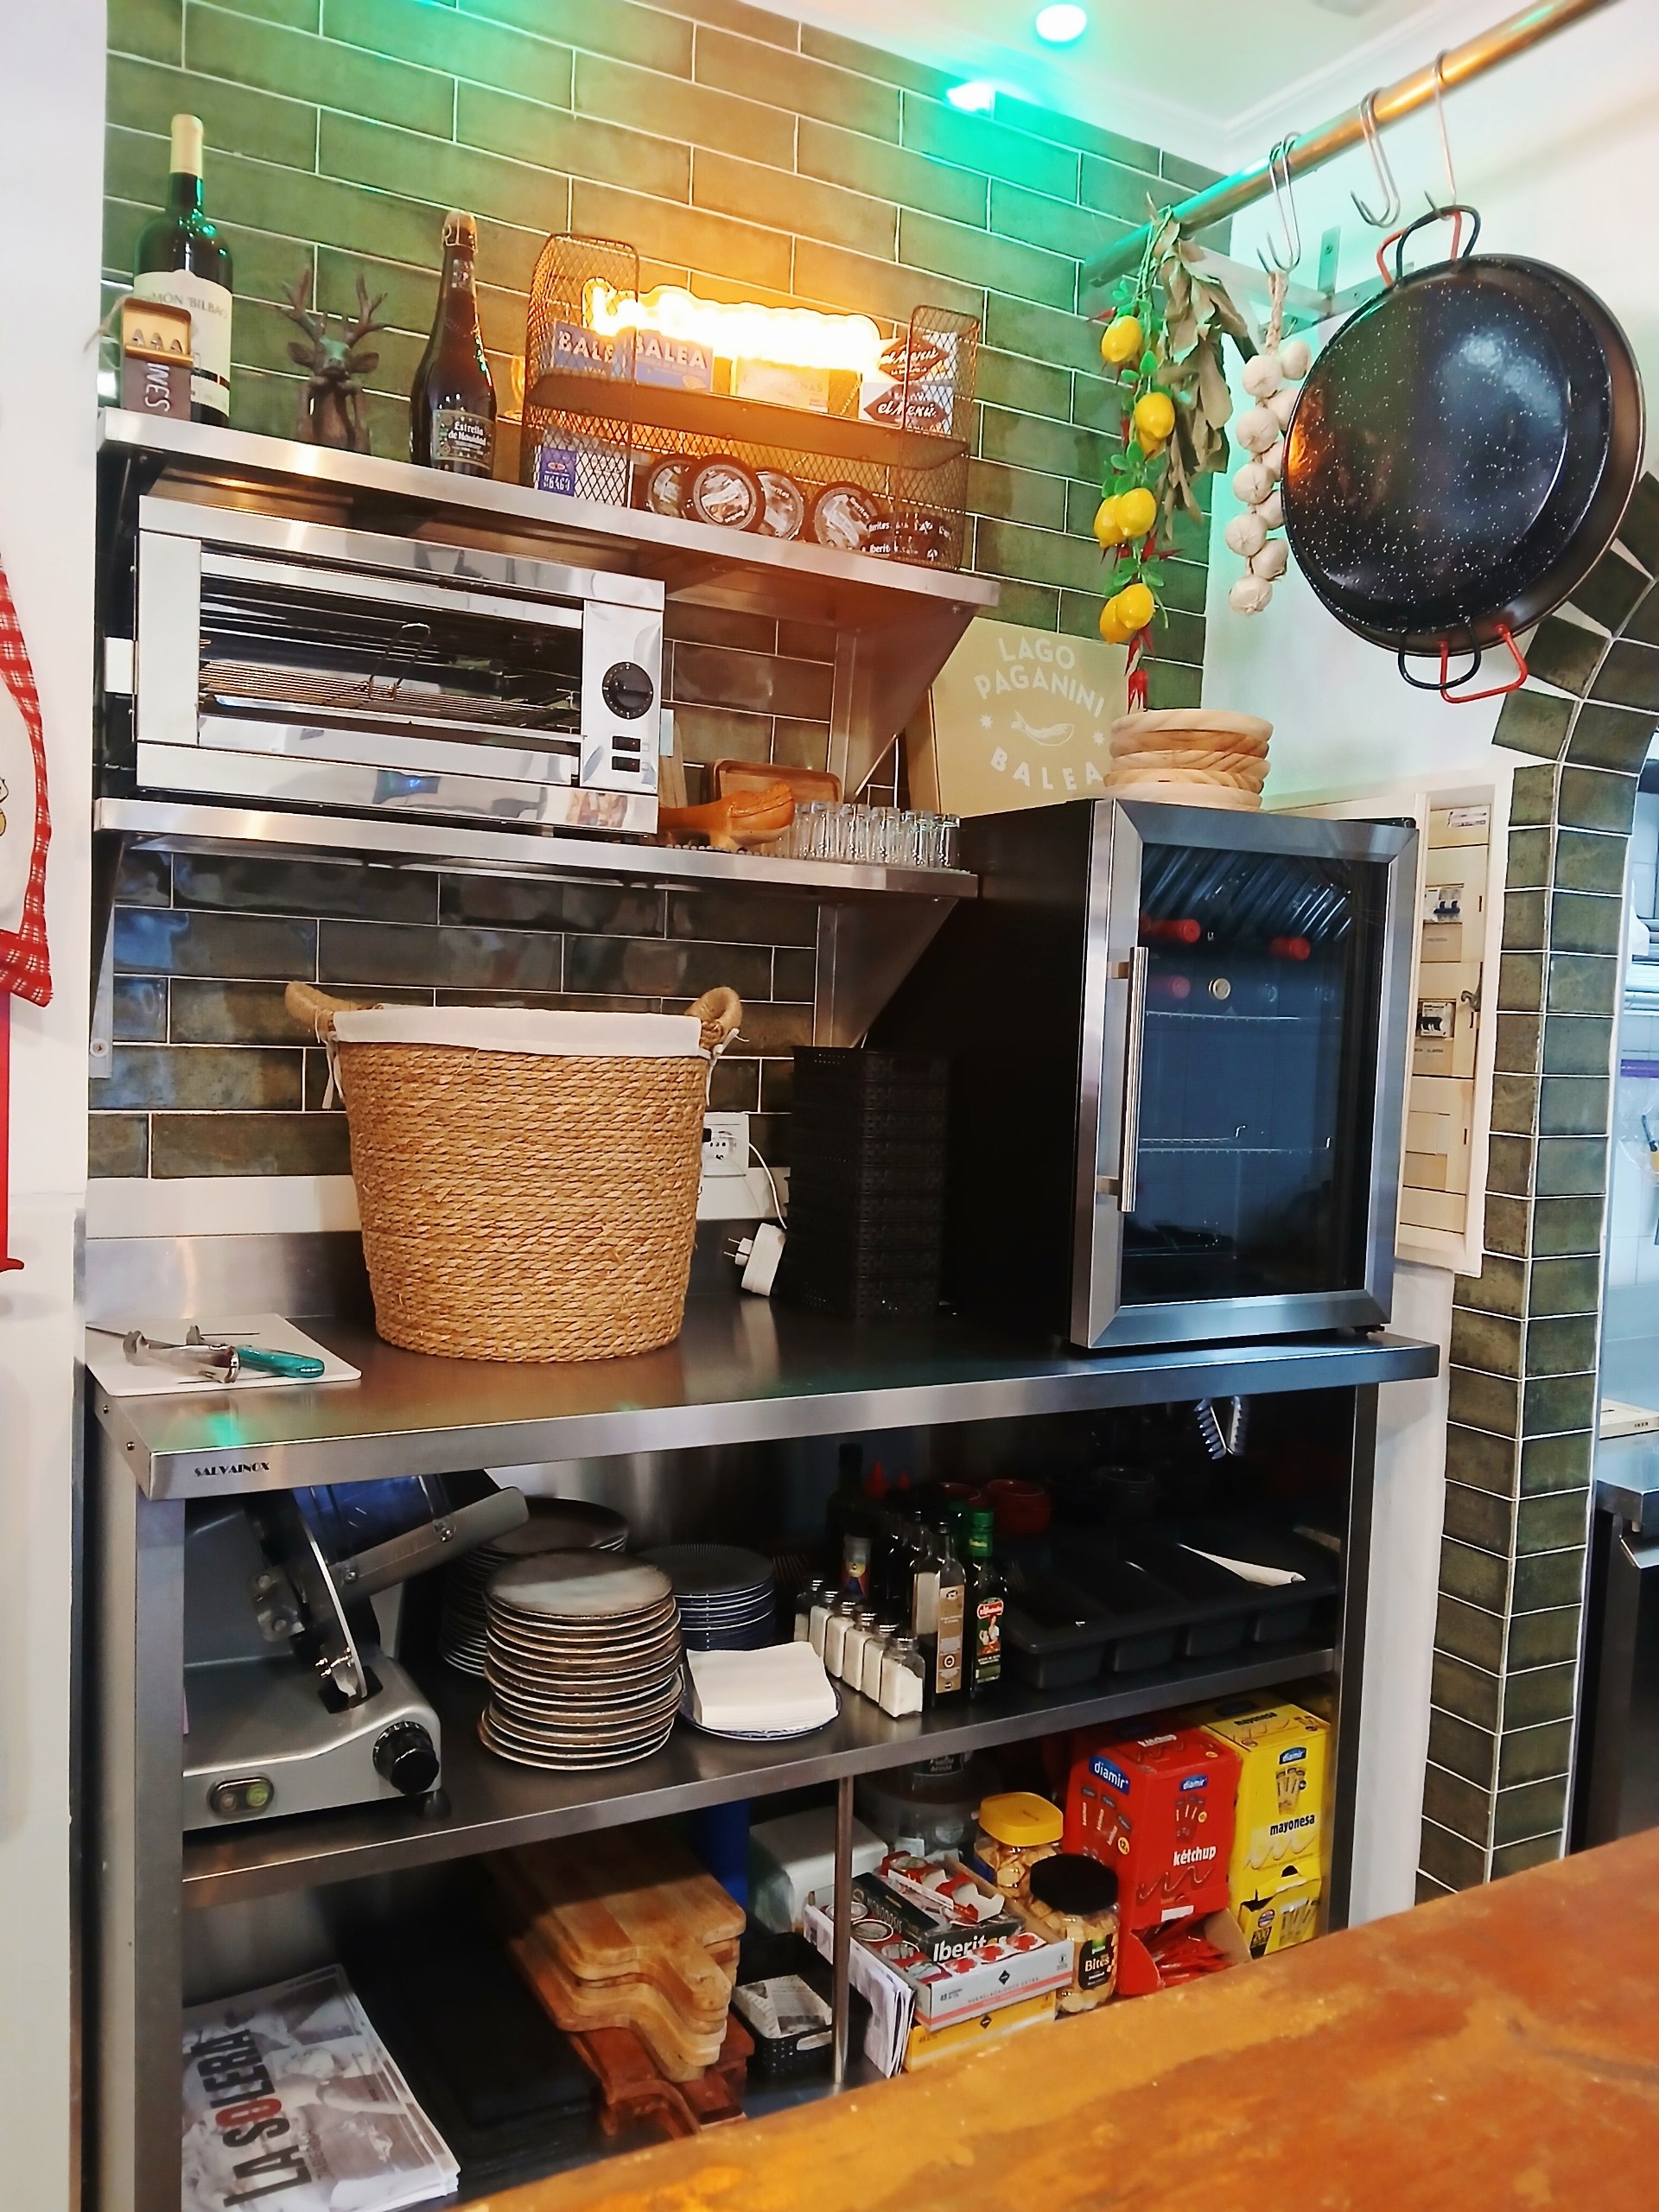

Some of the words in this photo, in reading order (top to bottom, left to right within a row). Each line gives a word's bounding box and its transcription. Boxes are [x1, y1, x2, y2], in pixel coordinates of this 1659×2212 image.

[633, 334, 707, 370] BALEA
[448, 429, 458, 439] de
[454, 421, 484, 436] Estrella
[998, 636, 1077, 671] LAGO
[974, 664, 1105, 718] PAGANINI
[990, 747, 1103, 791] BALEA
[194, 1462, 270, 1477] SALVAINOX
[1094, 1761, 1126, 1790] diamir
[1183, 1778, 1205, 1790] diamir
[1269, 1814, 1315, 1836] mayonesa
[1173, 1846, 1217, 1867] kétchup
[1084, 1958, 1110, 1973] Bites
[190, 2029, 291, 2148] SOLERA
[223, 2145, 313, 2208] LA
